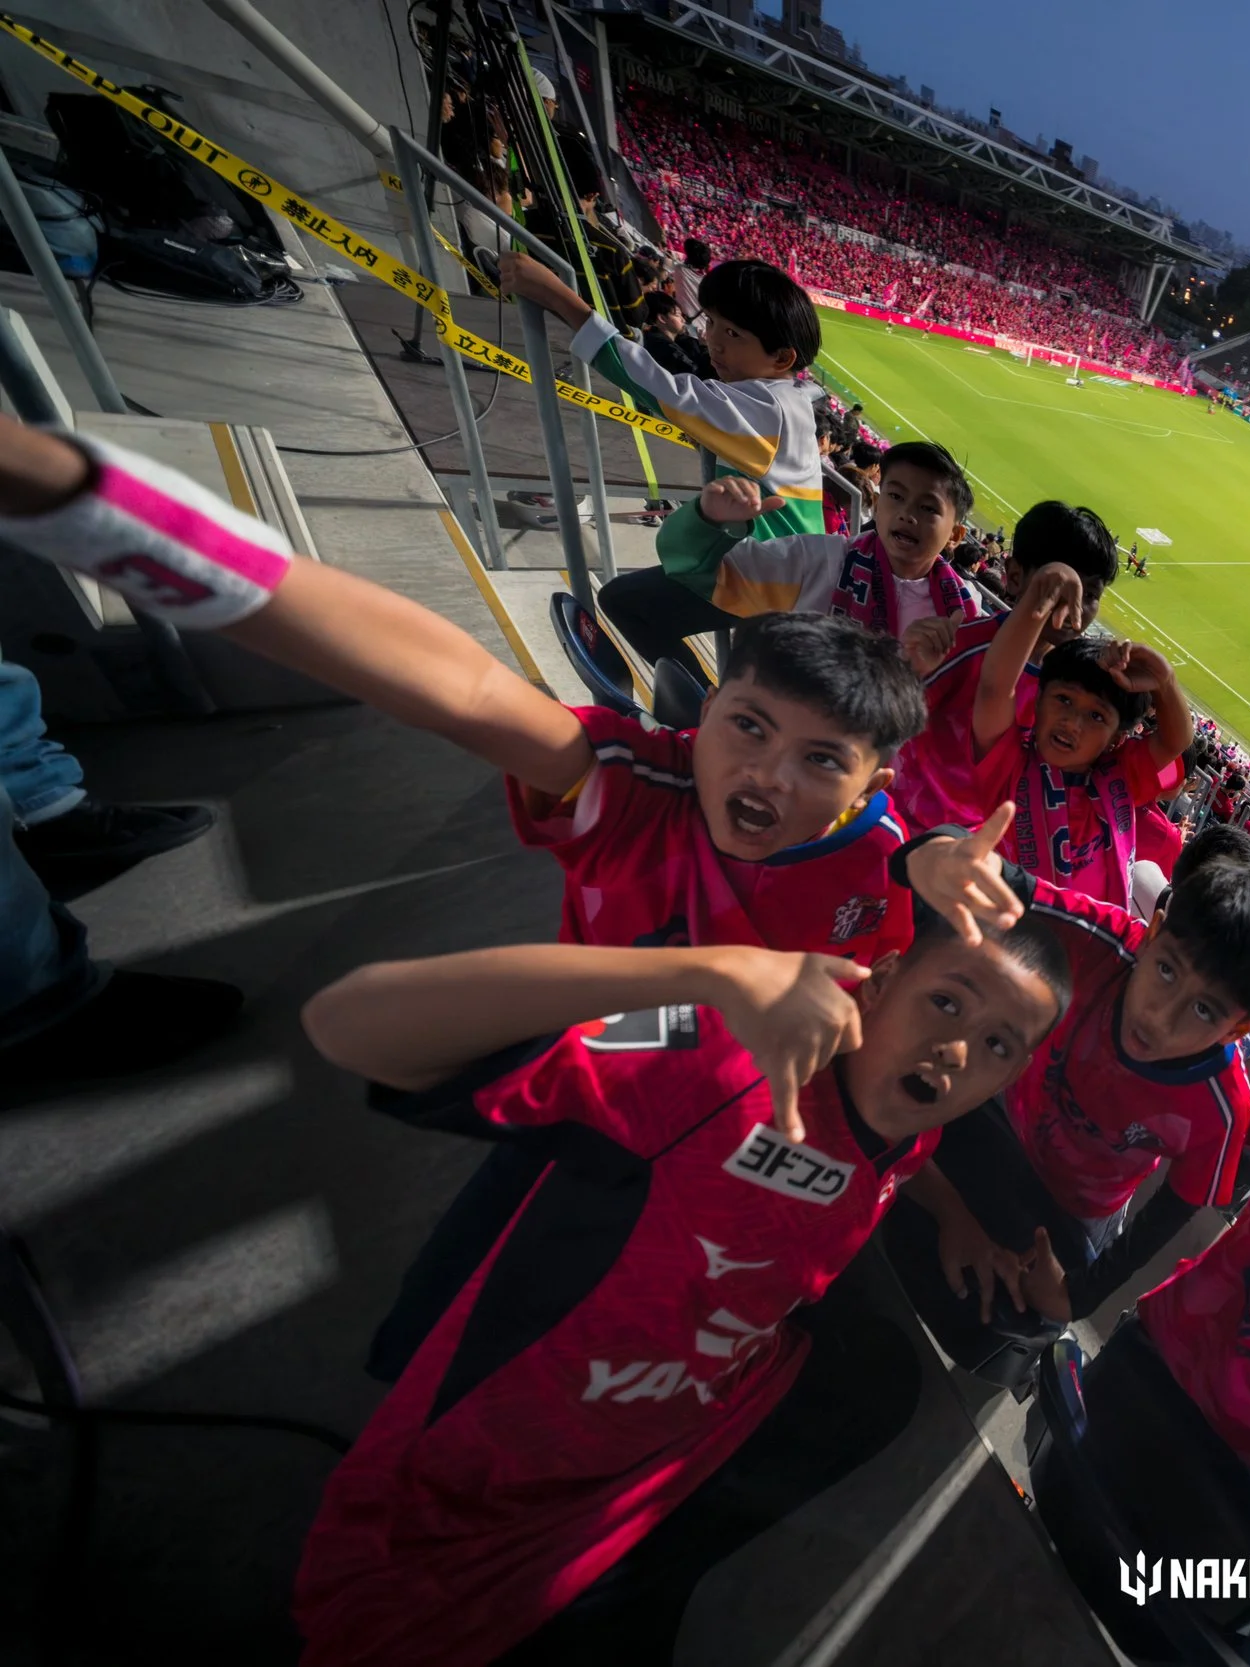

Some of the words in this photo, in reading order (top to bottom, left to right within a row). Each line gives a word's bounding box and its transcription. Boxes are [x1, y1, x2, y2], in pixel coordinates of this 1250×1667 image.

[141, 107, 228, 164] OUT
[281, 198, 378, 267] 禁止入内
[454, 335, 529, 378] 立入禁止
[555, 382, 601, 406] EEP
[609, 406, 652, 427] OUT
[1014, 776, 1039, 869] CEREZO
[1108, 778, 1133, 835] CLUB
[736, 1134, 846, 1197] ヨドコウ
